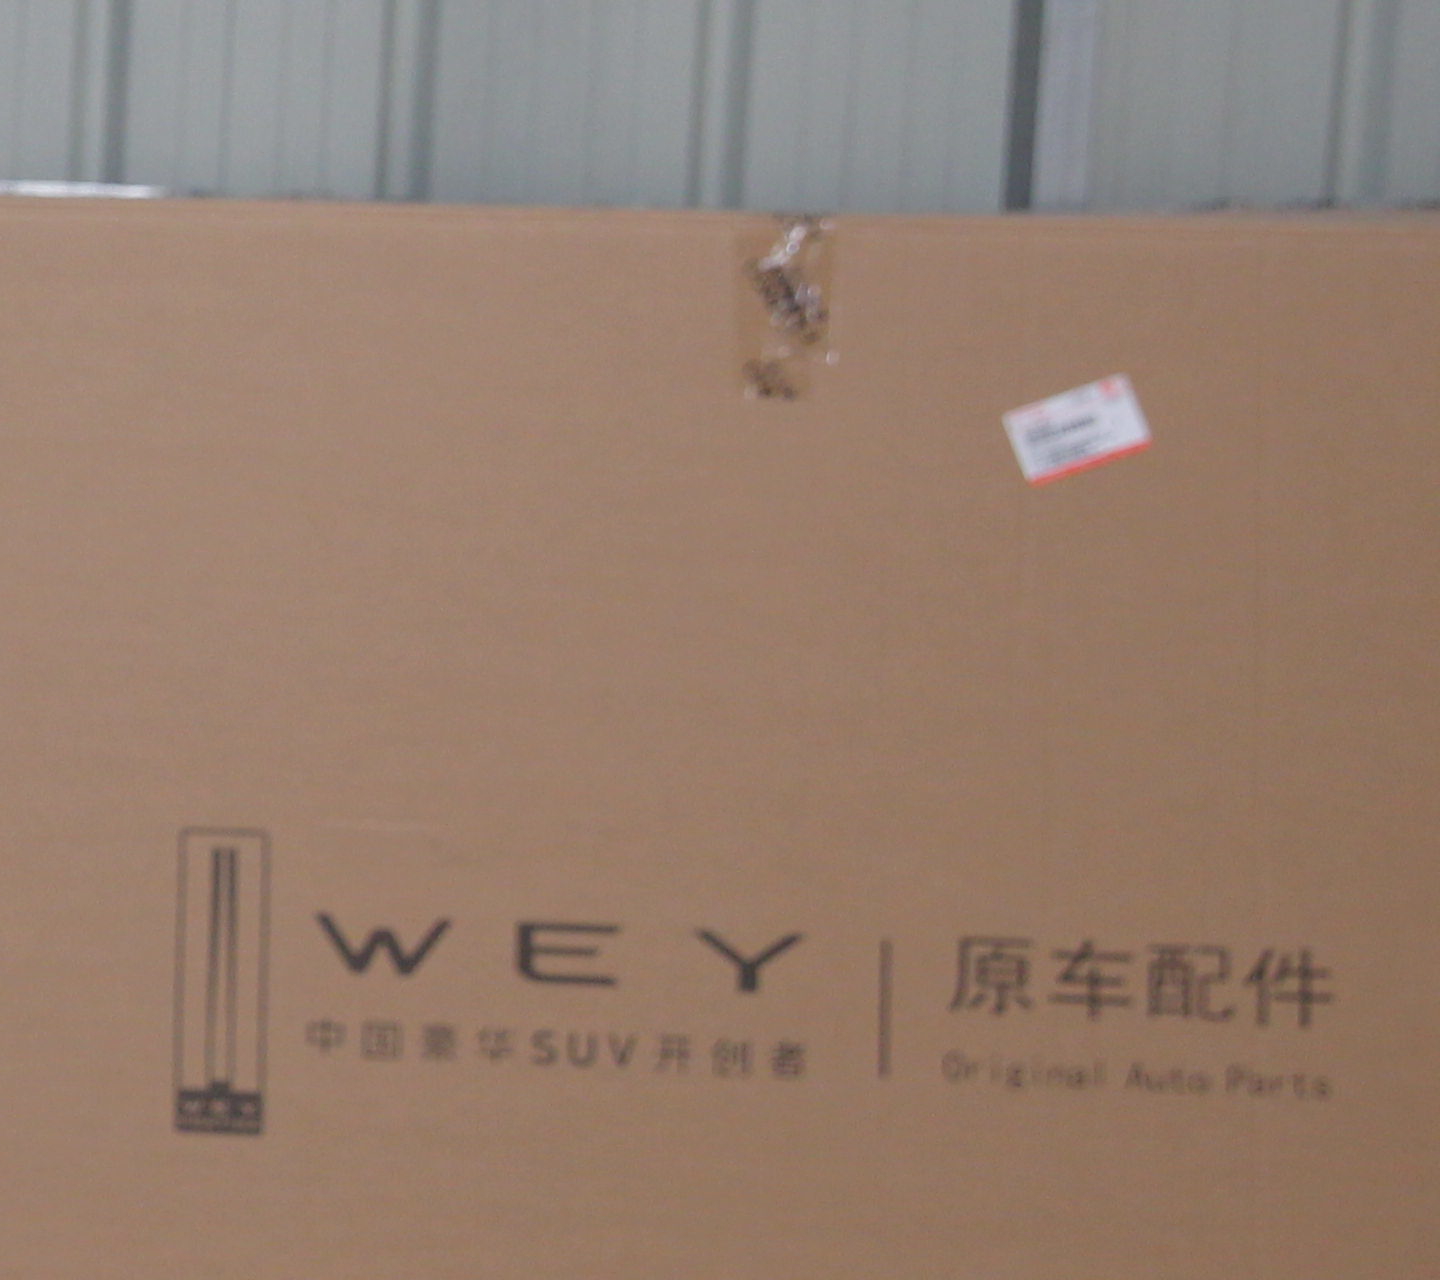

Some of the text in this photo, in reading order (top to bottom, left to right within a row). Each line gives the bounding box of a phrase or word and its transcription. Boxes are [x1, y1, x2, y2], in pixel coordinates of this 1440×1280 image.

[313, 911, 804, 993] WEY
[948, 934, 1335, 1029] 原车配件
[305, 1018, 807, 1079] 中国豪华SUV开创者
[941, 1048, 1334, 1101] Original Auto Parts
